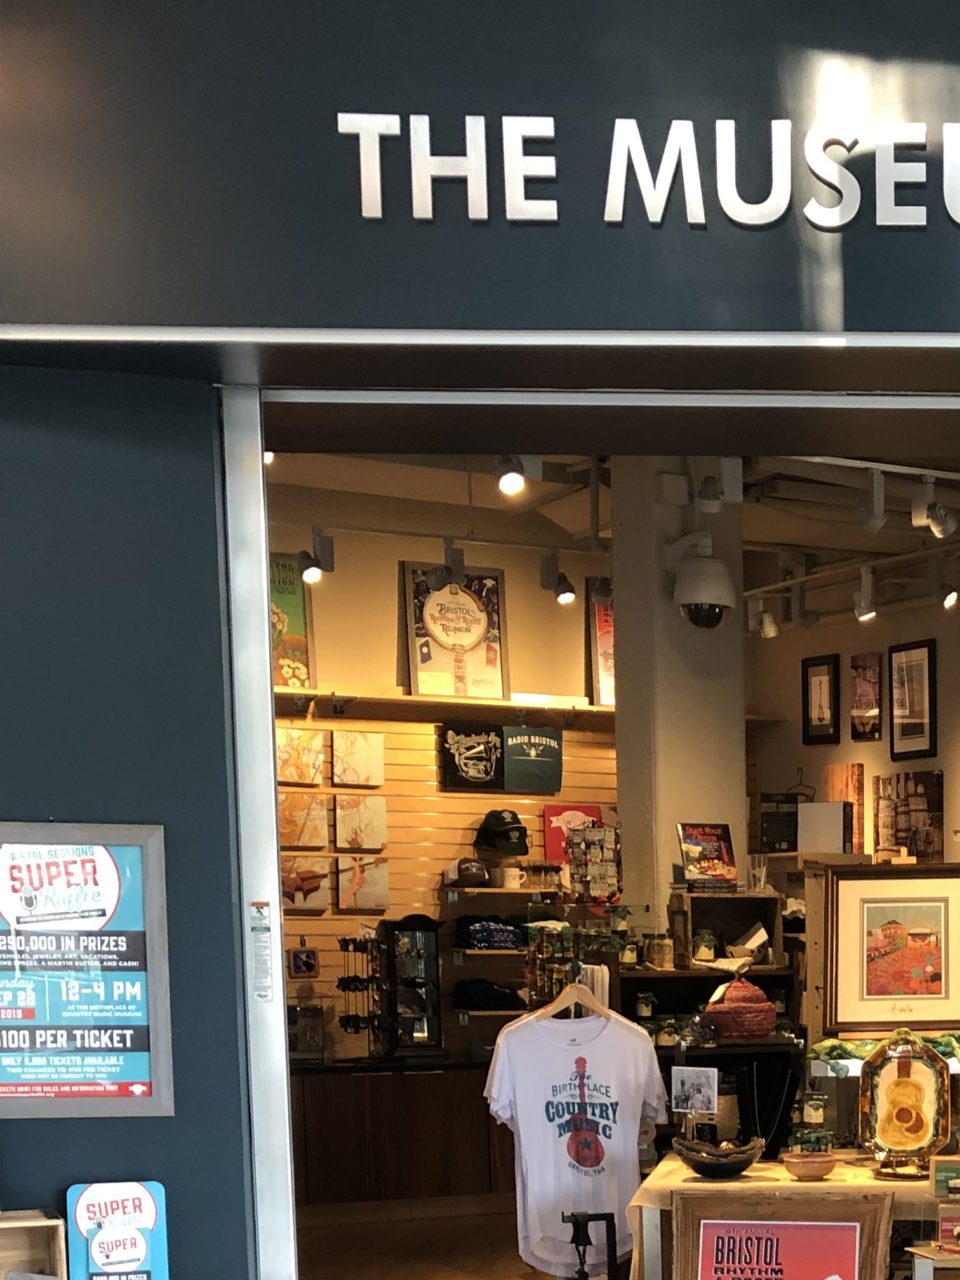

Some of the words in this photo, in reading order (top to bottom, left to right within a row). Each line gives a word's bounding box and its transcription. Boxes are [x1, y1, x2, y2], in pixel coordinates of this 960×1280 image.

[337, 113, 558, 221] THE
[436, 603, 475, 616] BRISTOL
[507, 735, 529, 746] RADIO
[530, 735, 559, 749] BRISTOL
[9, 858, 99, 893] SUPER
[61, 935, 75, 951] IN
[80, 935, 127, 951] PRIZES
[113, 981, 141, 1001] PM
[1, 1008, 22, 1018] 2019
[36, 1029, 67, 1048] PER
[73, 1029, 133, 1048] TICKET
[49, 1056, 81, 1065] TICKETS
[569, 1070, 592, 1081] The
[551, 1083, 611, 1098] BIRTHPLACE
[545, 1101, 619, 1124] COUNTRY
[557, 1118, 612, 1139] MUSIC
[86, 1197, 143, 1221] SUPER
[98, 1237, 137, 1254] SUPER
[715, 1236, 782, 1266] BRISTOL
[714, 1267, 784, 1276] RHYTHM
